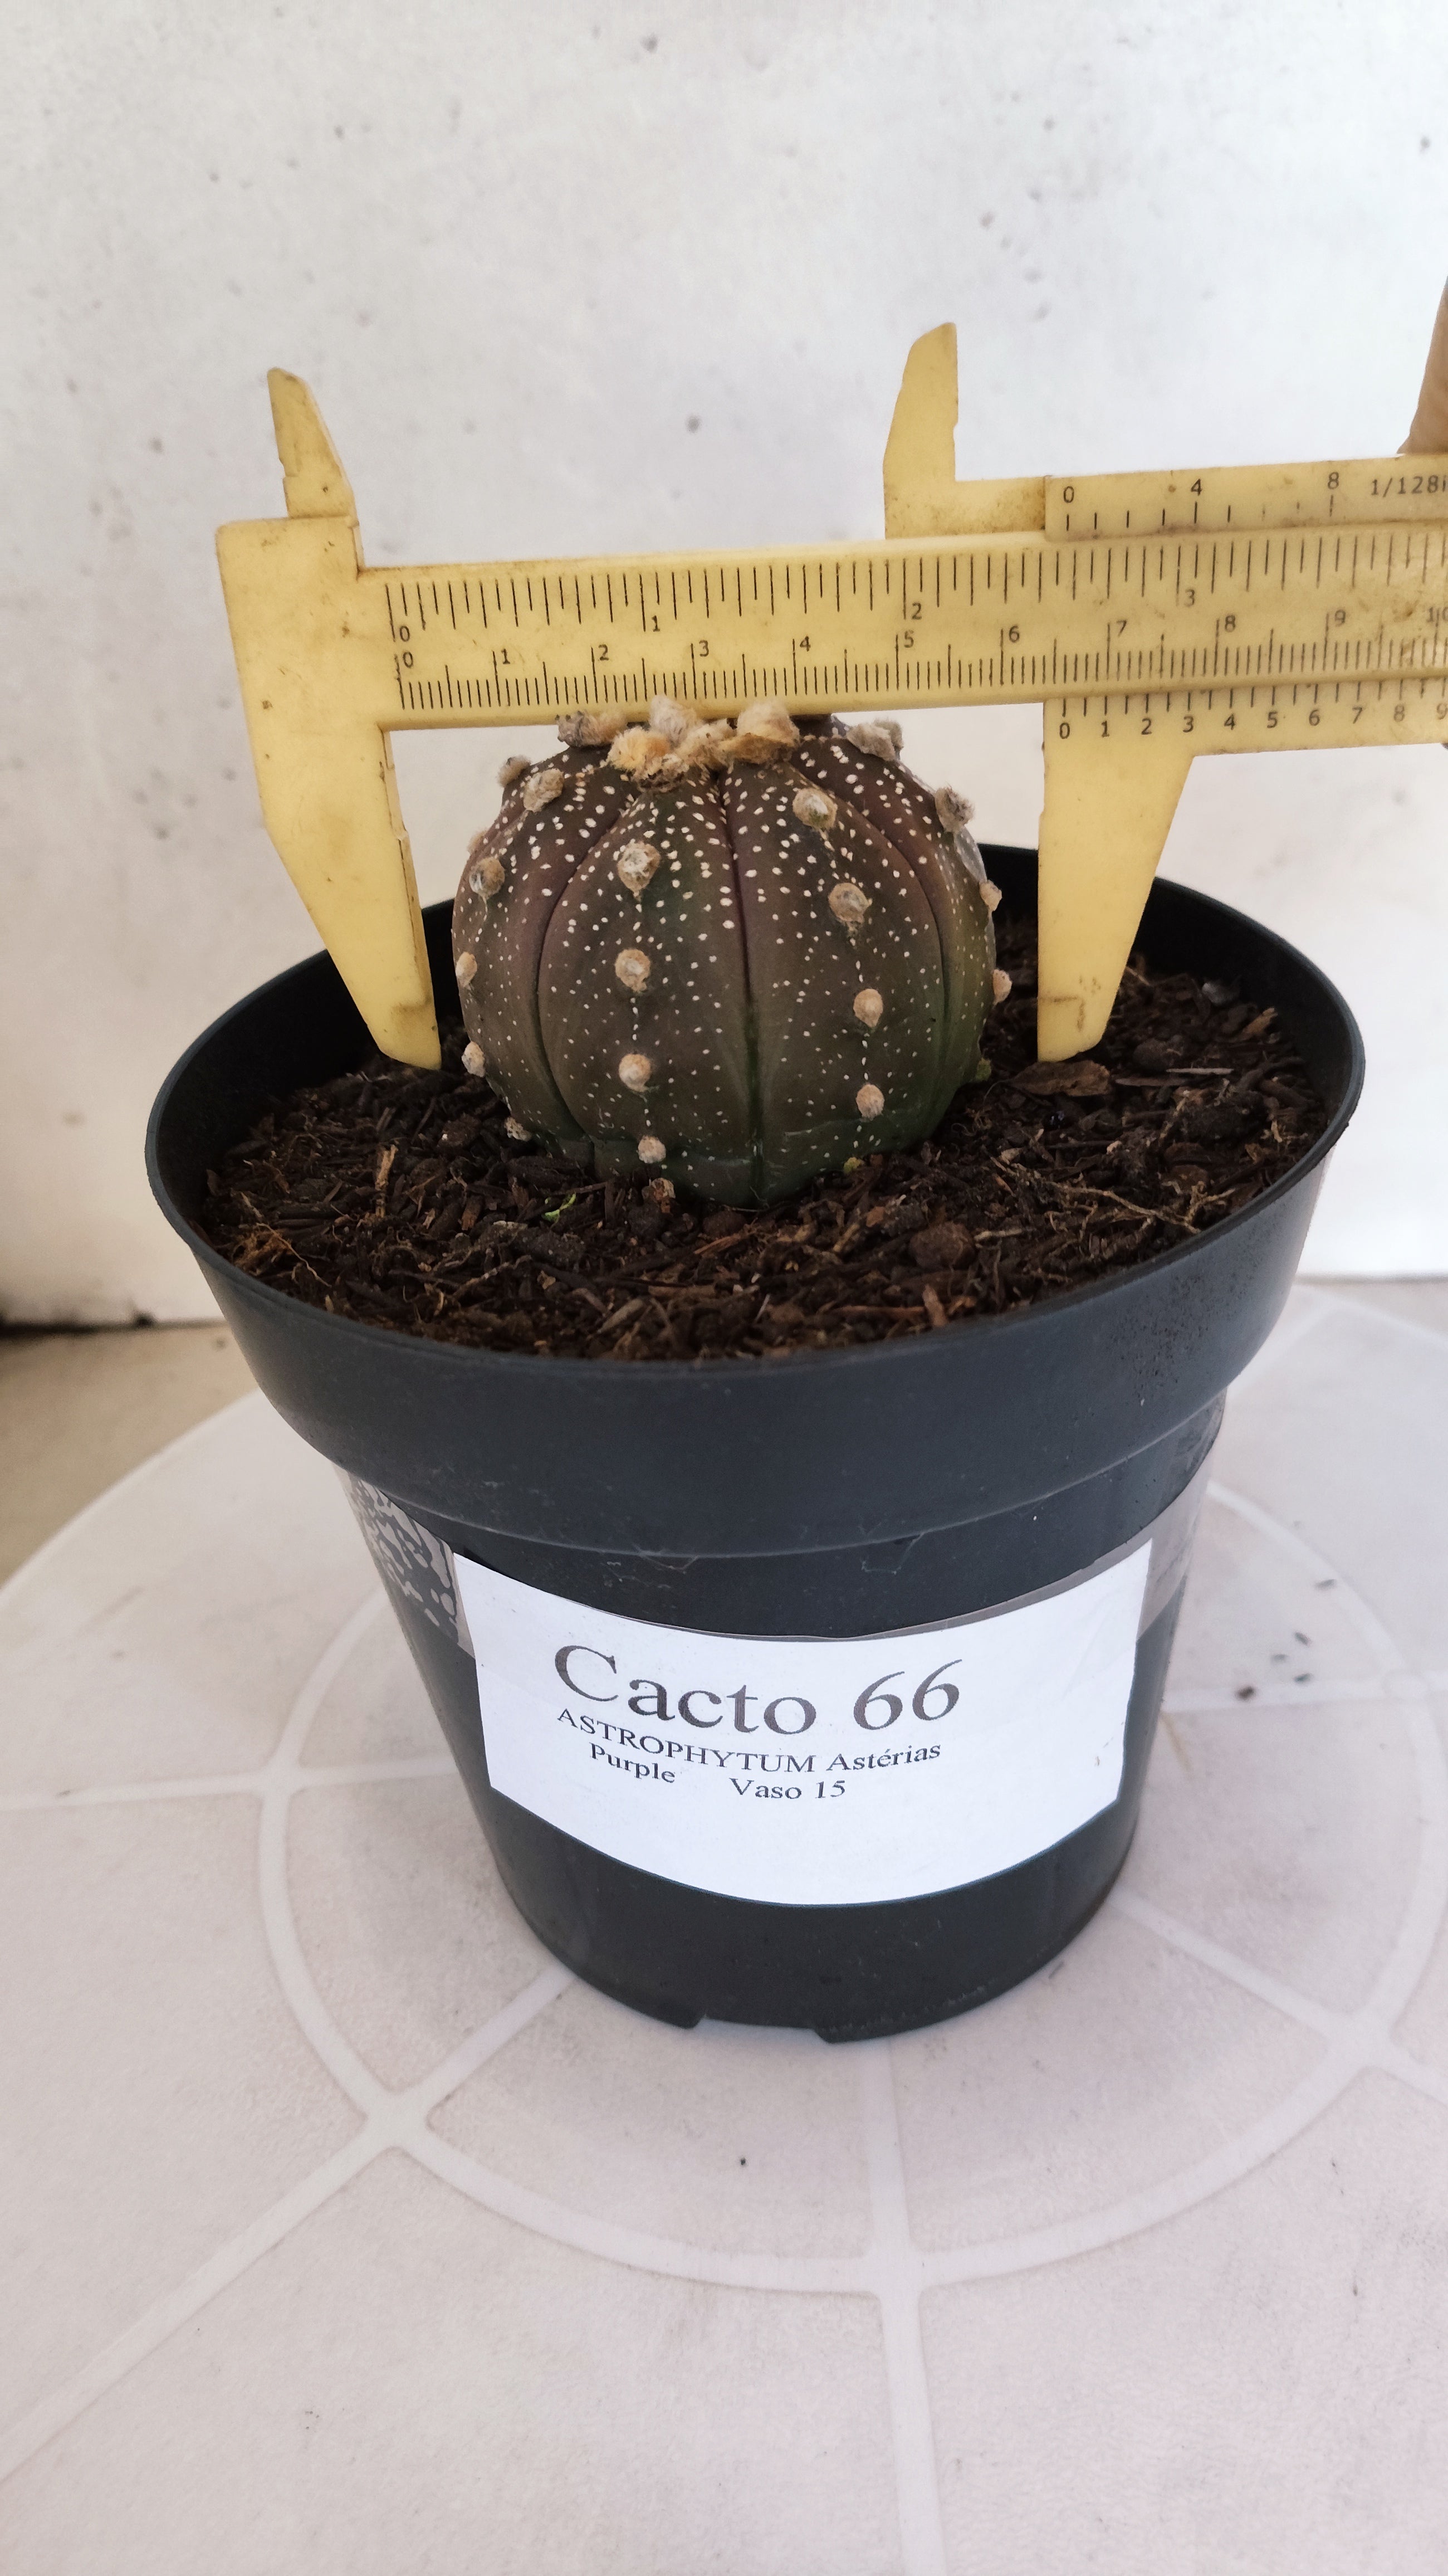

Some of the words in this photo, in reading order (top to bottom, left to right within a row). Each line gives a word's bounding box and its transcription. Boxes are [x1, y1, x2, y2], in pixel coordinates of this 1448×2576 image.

[1063, 486, 1075, 504] 0
[1190, 479, 1203, 496] 4
[1327, 471, 1339, 490] 8
[399, 625, 410, 642] 0
[651, 615, 661, 633] 1
[911, 602, 923, 621] 2
[1185, 589, 1196, 607] 3
[402, 651, 414, 669] 0
[501, 648, 511, 665] 1
[598, 644, 610, 661] 2
[698, 640, 710, 657] 3
[799, 635, 811, 652] 4
[904, 630, 915, 648] 5
[1008, 625, 1020, 643] 6
[1116, 619, 1128, 637] 7
[1224, 614, 1237, 632] 8
[1334, 609, 1347, 627] 9
[1059, 722, 1070, 739] 0
[1100, 720, 1111, 738] 1
[1141, 718, 1153, 735] 2
[1182, 715, 1194, 733] 3
[1224, 713, 1236, 731] 4
[1266, 711, 1278, 729] 5
[1308, 709, 1320, 726] 6
[1351, 705, 1364, 724] 7
[1393, 704, 1405, 723] 8
[1436, 702, 1448, 720] 9
[554, 1645, 818, 1735] Cacto
[853, 1658, 963, 1731] 66
[556, 1708, 814, 1774] ASTROPHYTUM
[826, 1745, 941, 1772] Astérias
[589, 1743, 676, 1784] Purple
[728, 1777, 802, 1800] Vaso
[815, 1780, 846, 1799] 15
